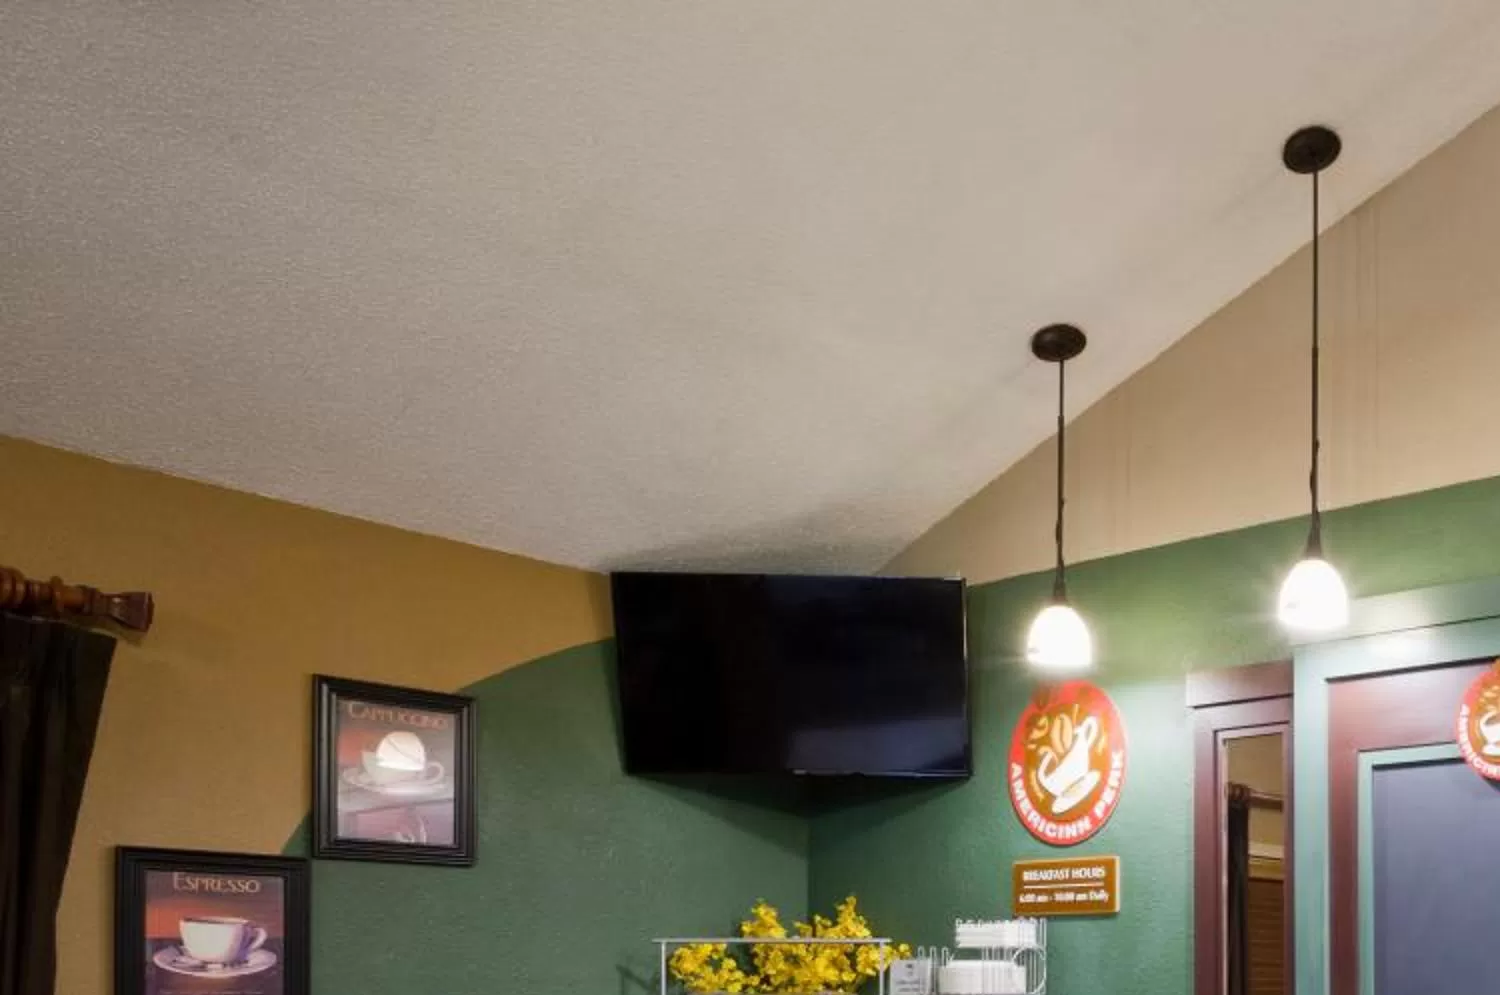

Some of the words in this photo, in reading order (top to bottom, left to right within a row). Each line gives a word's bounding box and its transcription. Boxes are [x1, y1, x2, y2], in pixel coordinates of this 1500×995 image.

[1011, 762, 1093, 839] AMERICINN
[1094, 749, 1124, 818] PERK
[173, 871, 260, 895] ESPRESSO
[1071, 866, 1106, 879] HOURS
